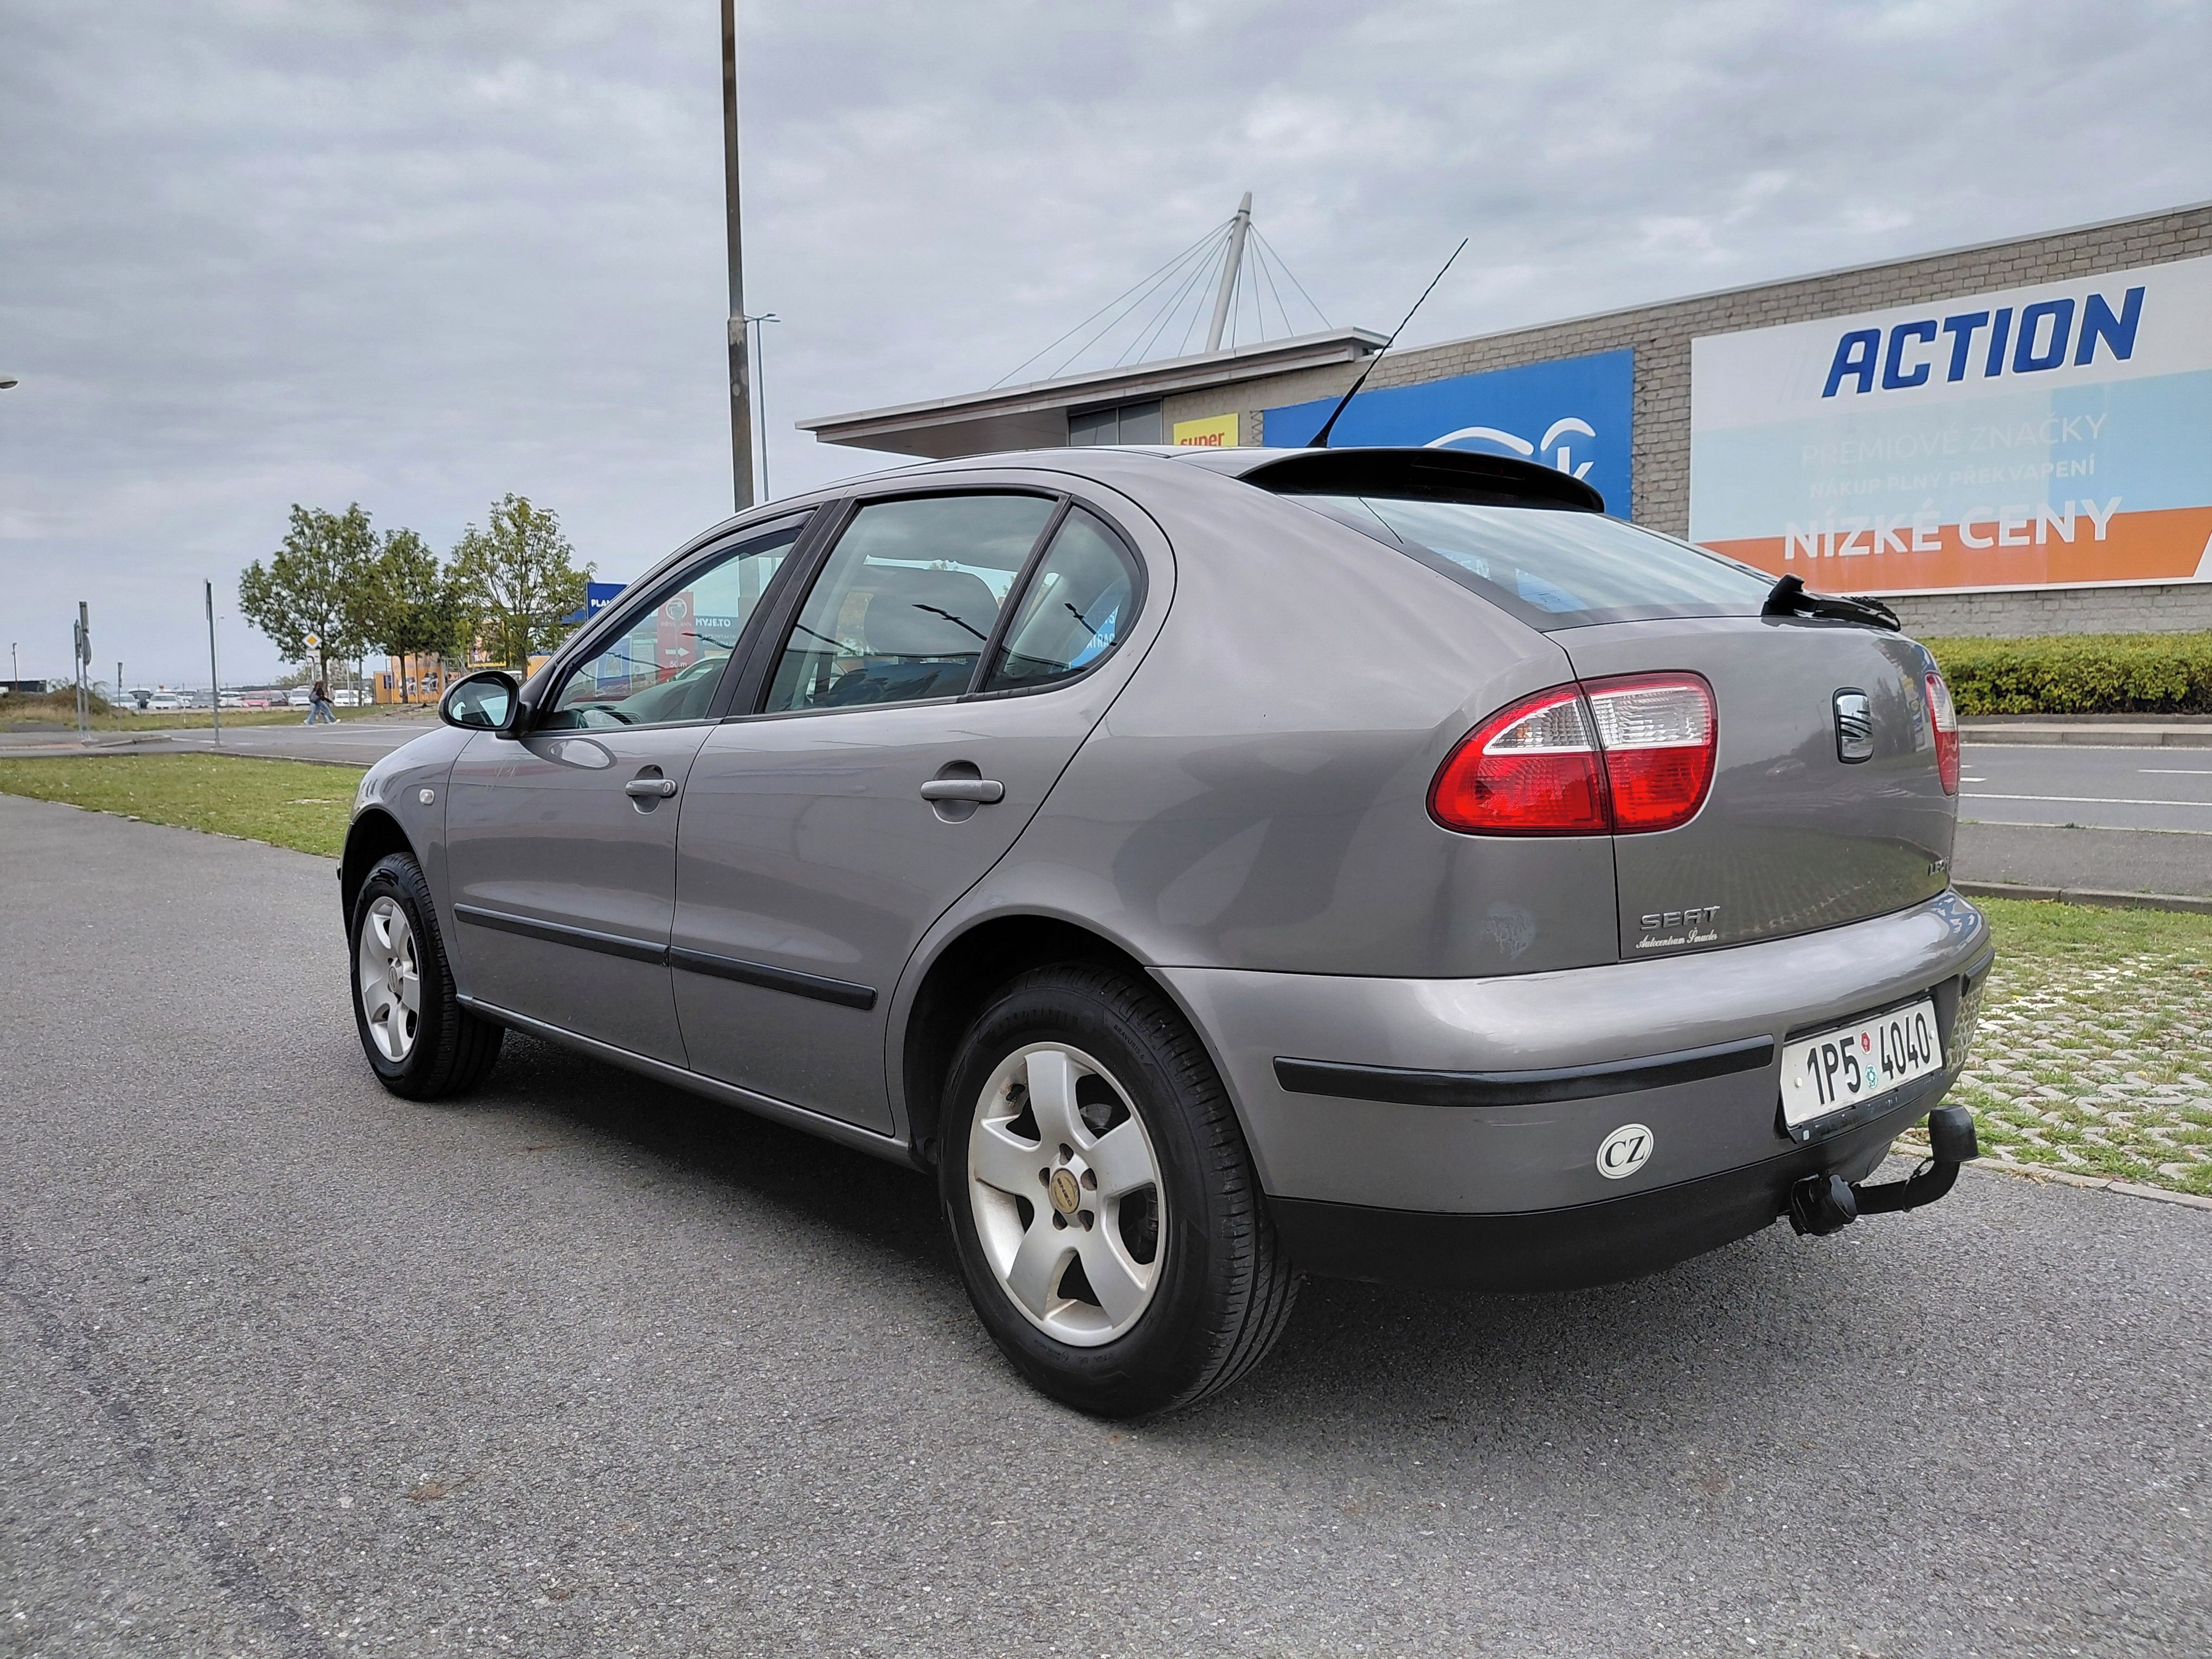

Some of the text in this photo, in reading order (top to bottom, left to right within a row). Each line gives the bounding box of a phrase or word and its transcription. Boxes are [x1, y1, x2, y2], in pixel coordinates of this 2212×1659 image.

[1822, 286, 2145, 398] ACTION
[1801, 411, 2108, 468] PRÉMIOVÉ ZNAČKY
[1810, 453, 2095, 499] NÁKUP PLNÝ PŘEKVAPENÍ
[1784, 496, 2123, 560] NÍZKÉ CENY
[695, 618, 731, 627] MYJE.TO
[1640, 905, 1721, 931] SEAT
[1114, 1024, 1141, 1054] BRAVURIS
[1806, 1012, 1931, 1105] 1P5 4040
[1605, 1135, 1645, 1168] CZ
